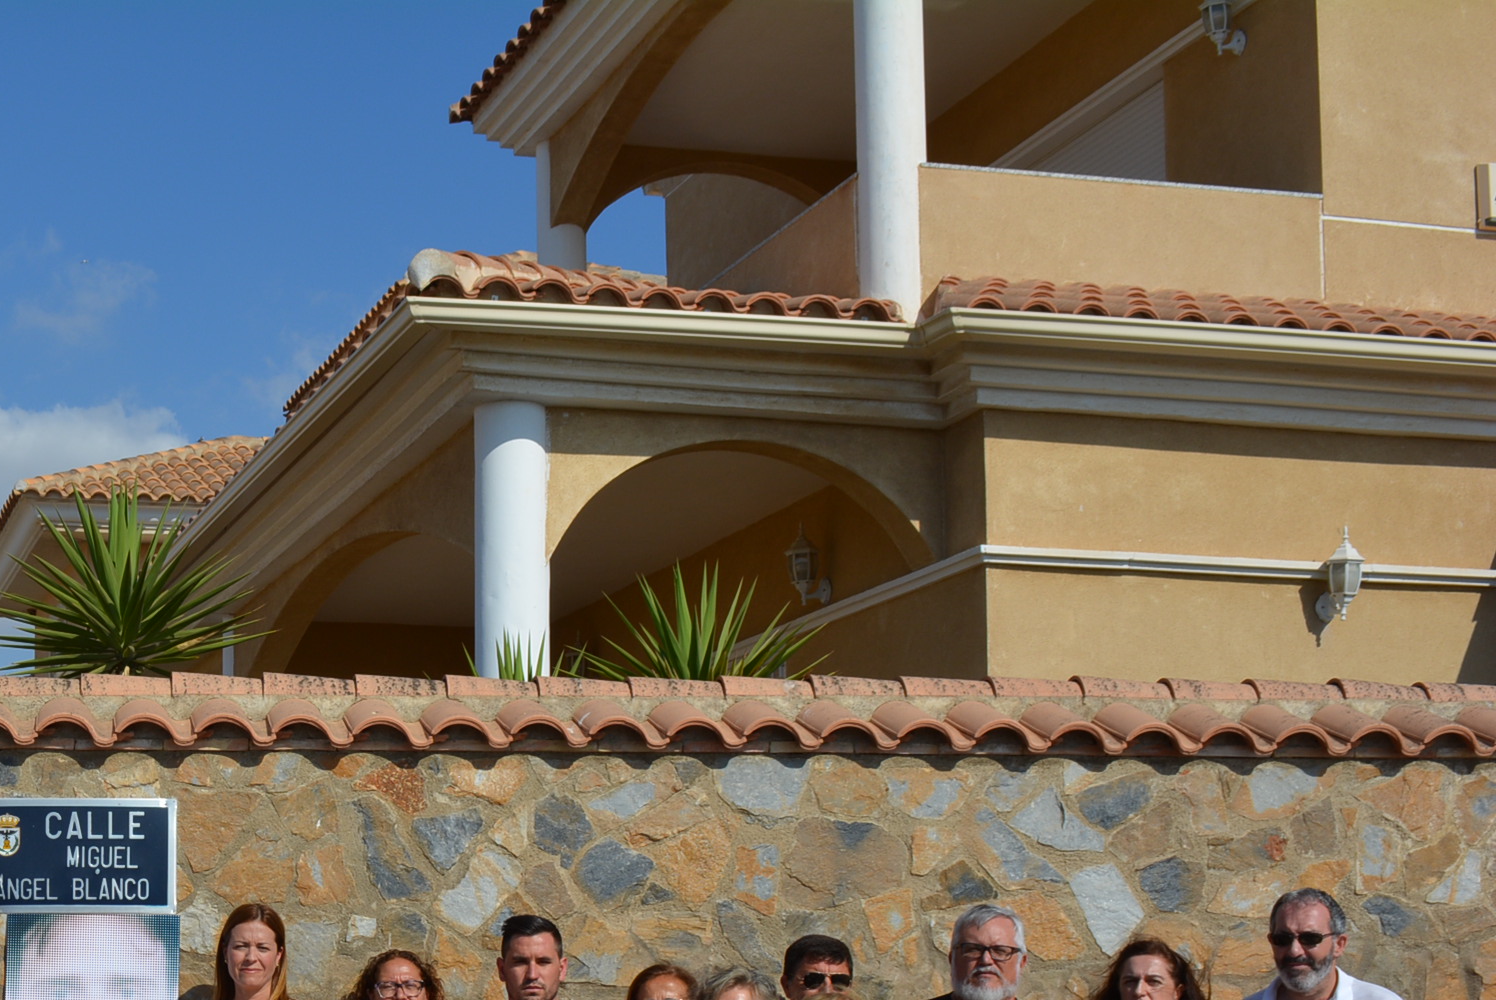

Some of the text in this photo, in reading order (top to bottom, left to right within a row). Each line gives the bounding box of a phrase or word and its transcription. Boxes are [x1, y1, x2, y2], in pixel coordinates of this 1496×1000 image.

[45, 811, 146, 840] CALLE
[66, 845, 139, 869] MIGUEL
[72, 877, 150, 900] BLANCO
